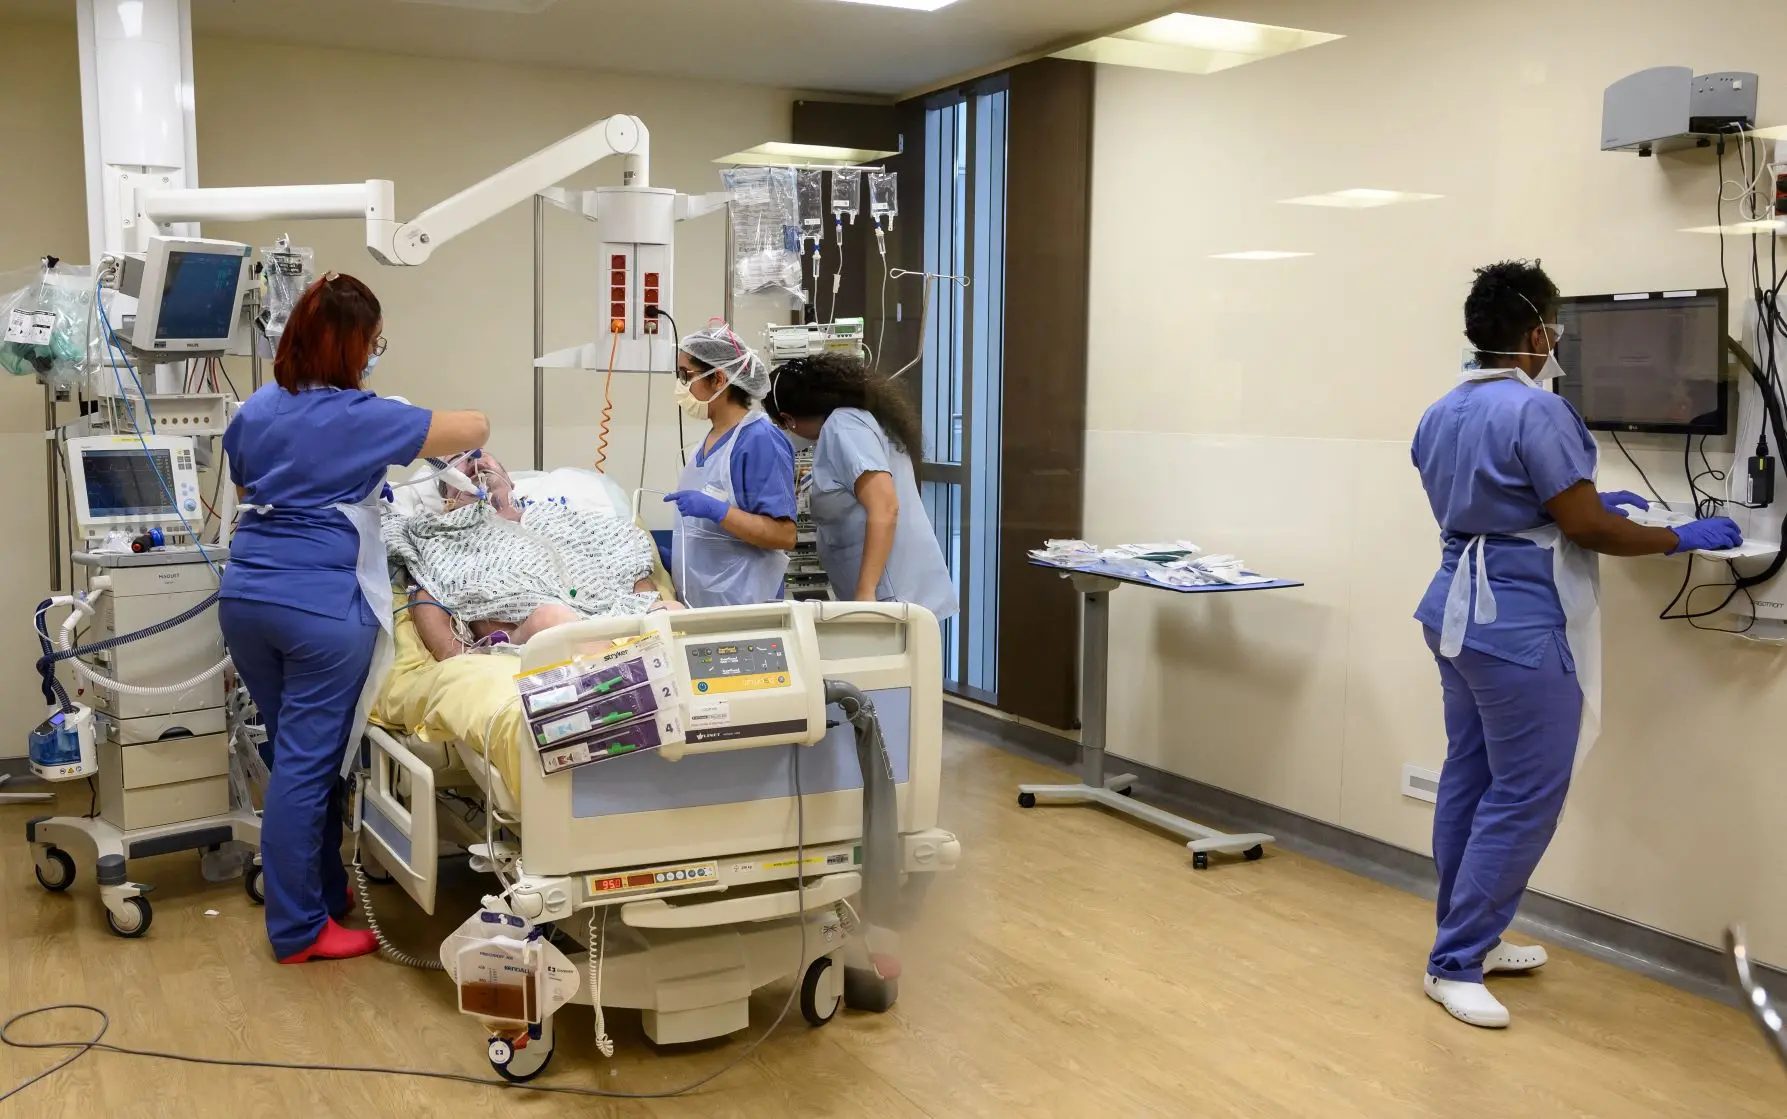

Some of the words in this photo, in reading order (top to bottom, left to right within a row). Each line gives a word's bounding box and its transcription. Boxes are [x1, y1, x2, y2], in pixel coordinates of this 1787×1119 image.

[603, 649, 628, 661] stryker
[653, 658, 661, 668] 3
[662, 687, 671, 698] 2
[665, 723, 673, 733] 4
